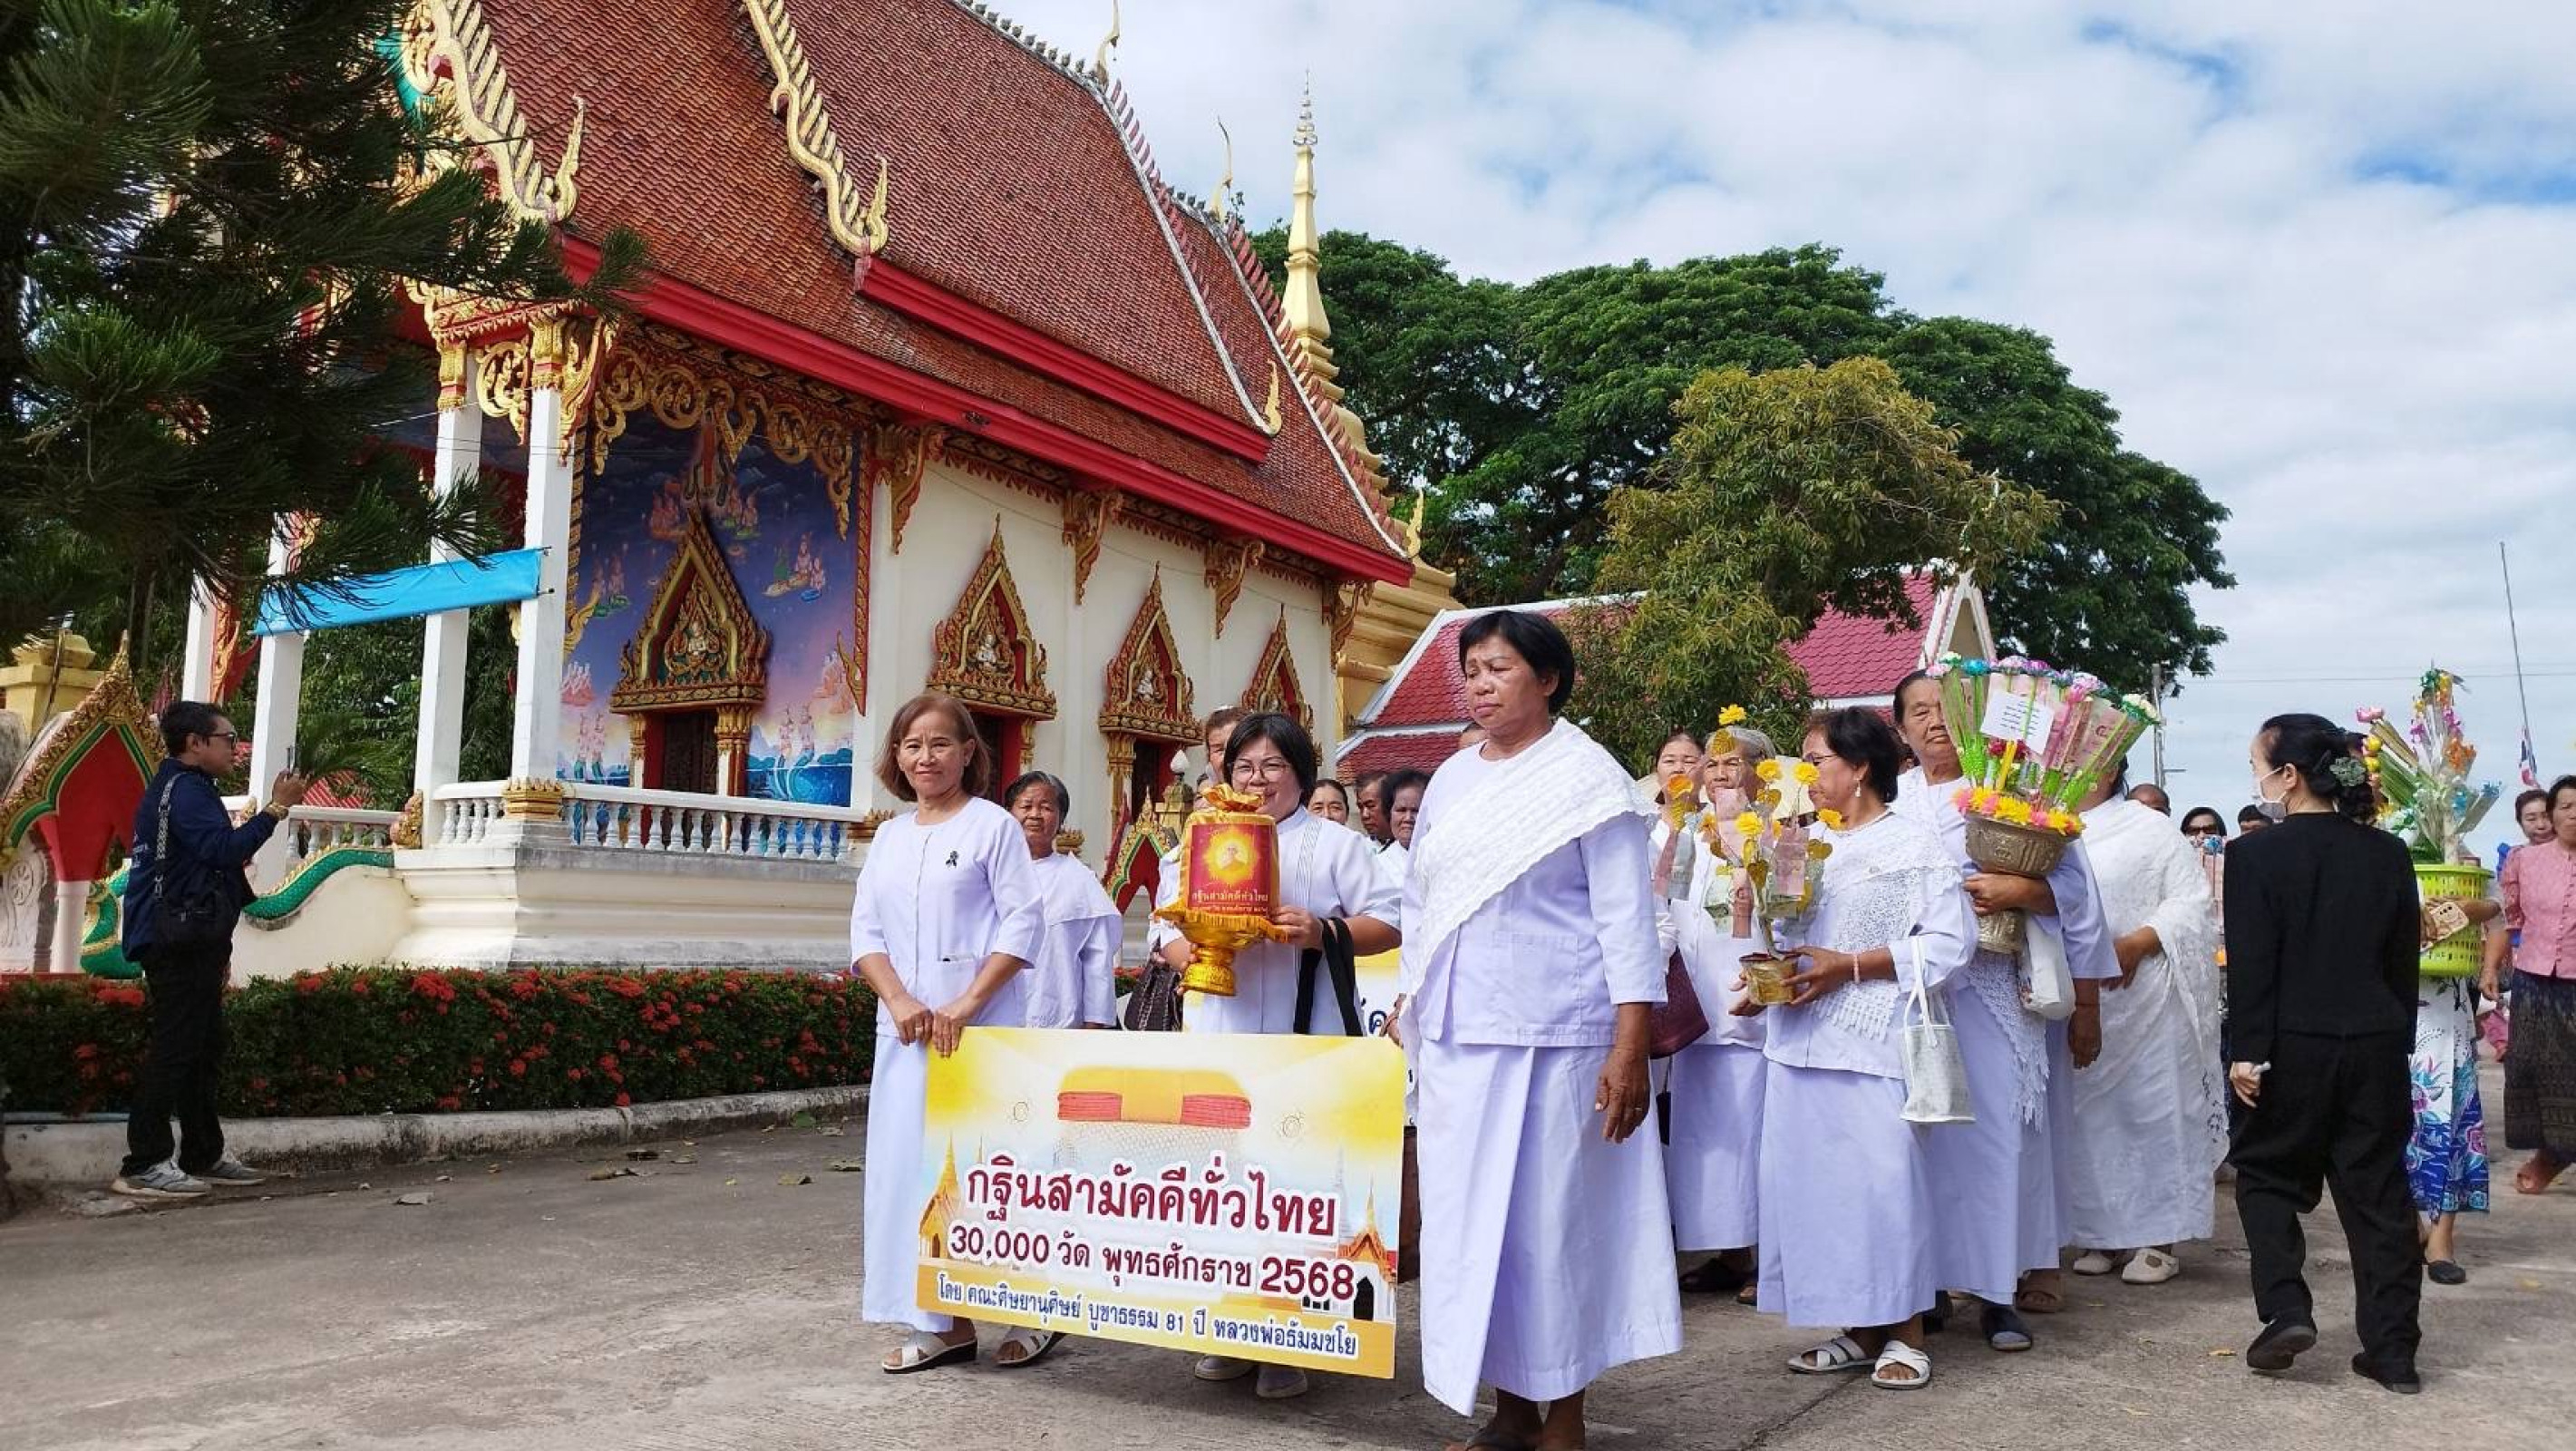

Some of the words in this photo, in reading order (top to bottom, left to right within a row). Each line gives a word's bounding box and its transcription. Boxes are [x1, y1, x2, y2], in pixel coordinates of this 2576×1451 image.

[967, 1154, 1337, 1236] กฐินสามัคคีทั่วไทย
[951, 1225, 1050, 1263] 30,000
[1057, 1231, 1091, 1268] วัด
[1103, 1242, 1251, 1287] พุทธศักราช
[1259, 1257, 1355, 1300] 2568
[939, 1274, 962, 1300] โดย
[968, 1283, 1082, 1323] คณะศิษยานุศิษย์
[1089, 1303, 1159, 1330] บูชาธรรม
[1166, 1314, 1183, 1332] 81
[1193, 1309, 1207, 1335] ปี
[1215, 1317, 1356, 1355] หลวงพ่อธัมมชโย
